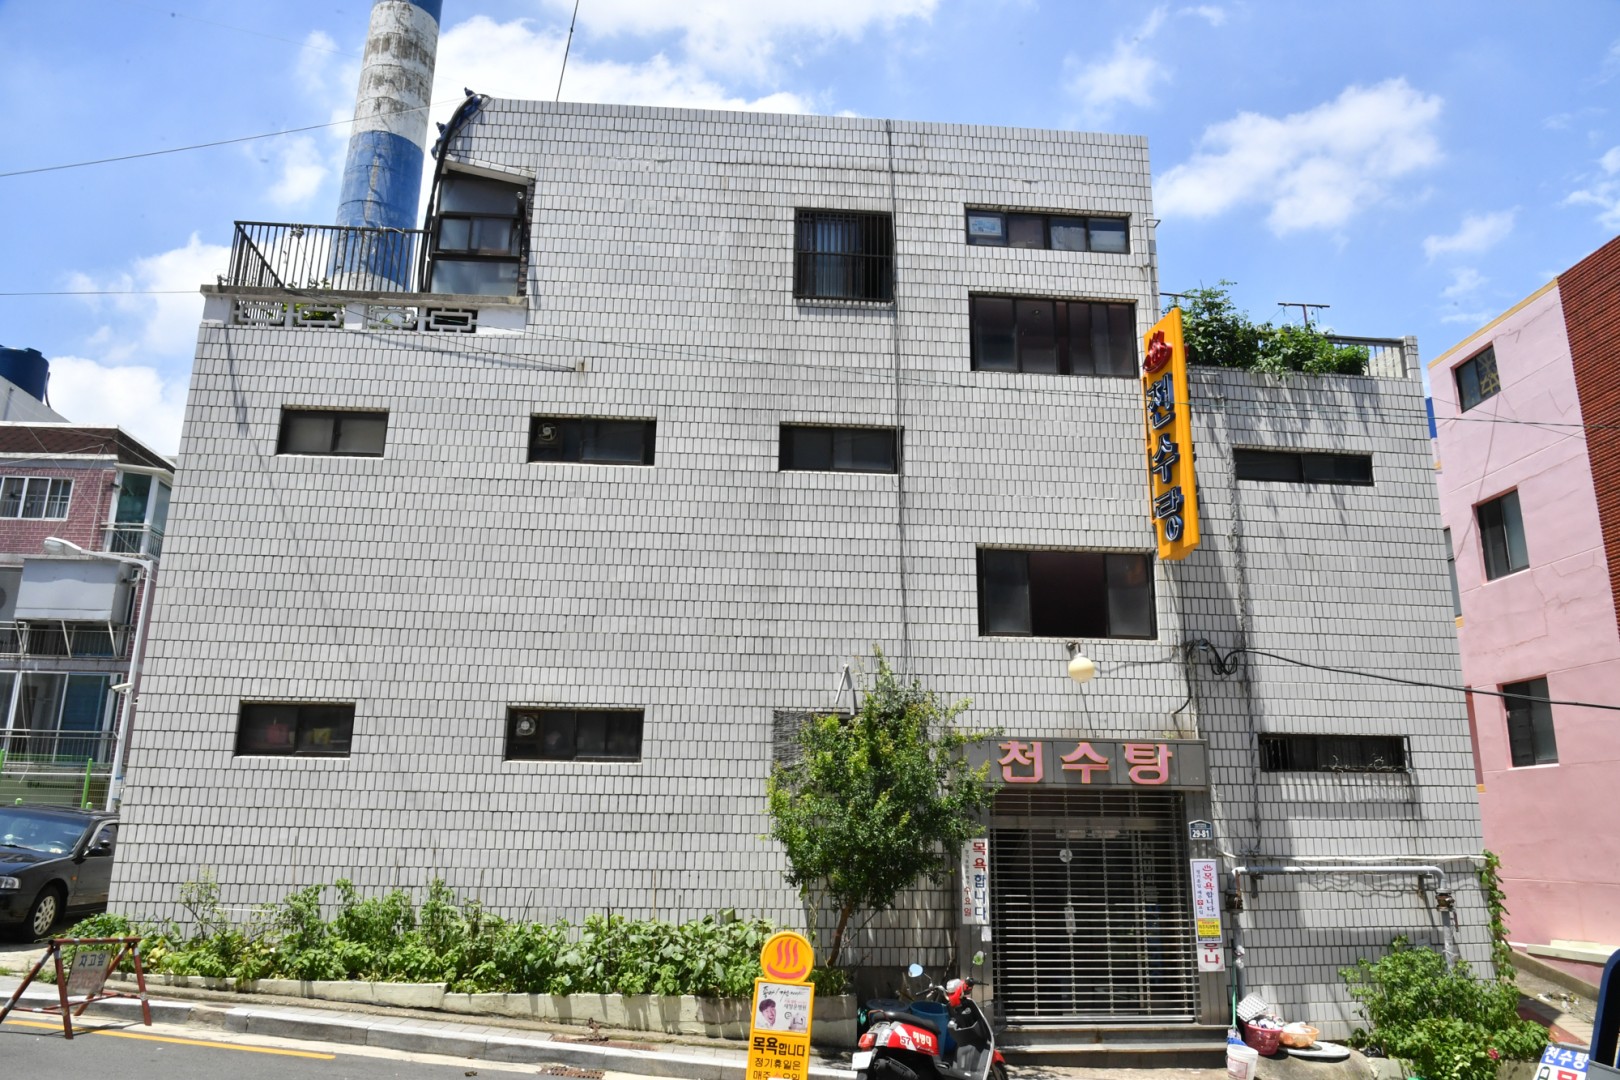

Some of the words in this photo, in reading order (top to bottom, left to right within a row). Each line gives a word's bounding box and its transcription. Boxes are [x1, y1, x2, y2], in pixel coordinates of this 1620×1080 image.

[1147, 373, 1183, 542] 천수탕
[998, 741, 1173, 785] 천수탕
[1192, 829, 1210, 838] 29-81
[973, 842, 987, 920] 목욕합니다
[1203, 873, 1215, 913] 목욕합니다
[753, 1037, 806, 1057] 목욕합니다
[1545, 1046, 1589, 1069] 천수탕
[755, 1057, 801, 1071] 정기휴일은
